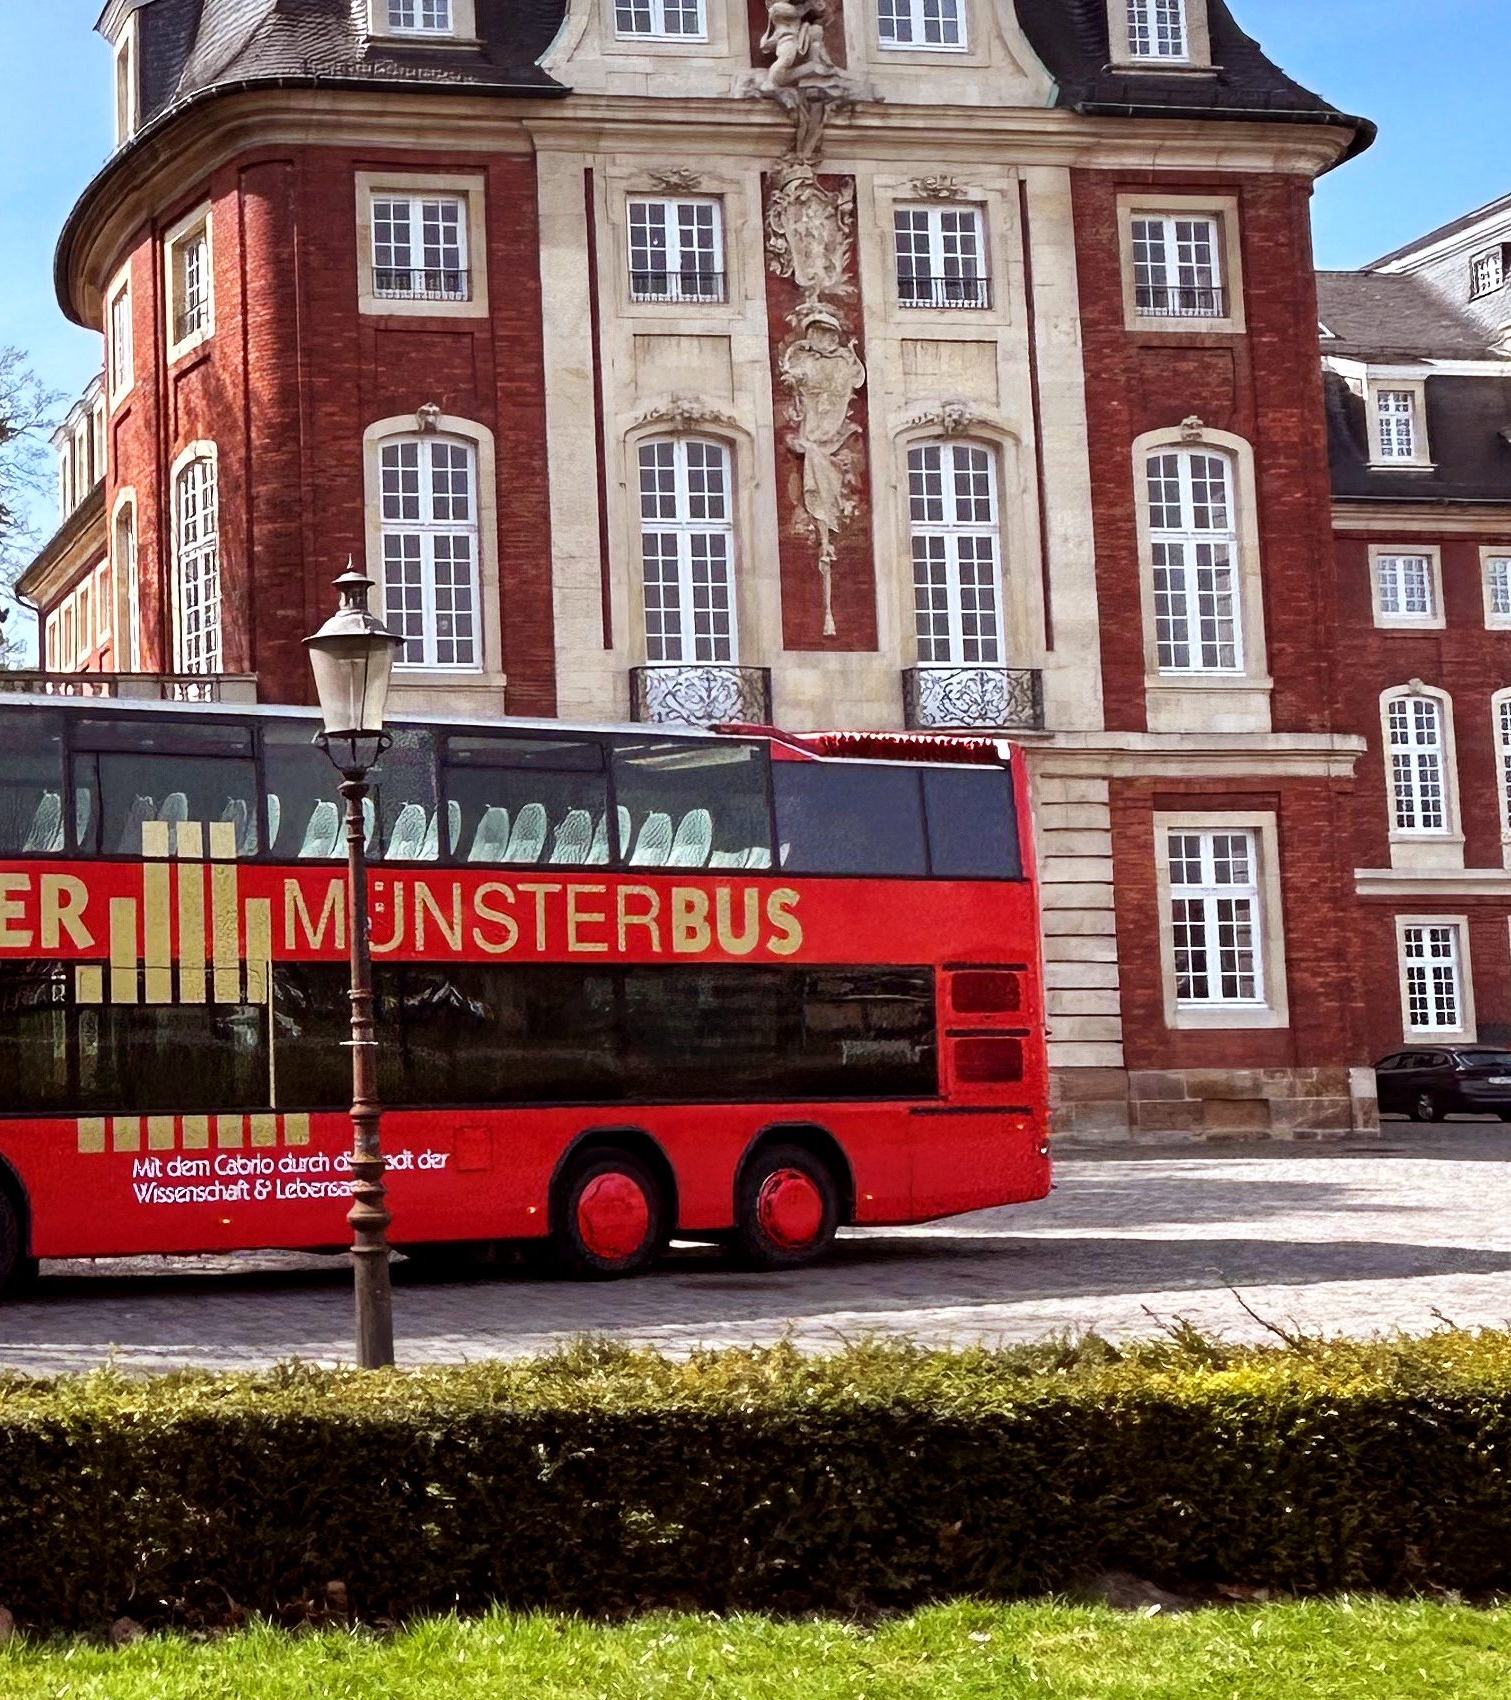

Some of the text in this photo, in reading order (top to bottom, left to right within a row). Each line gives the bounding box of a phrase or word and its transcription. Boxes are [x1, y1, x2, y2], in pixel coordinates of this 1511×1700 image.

[283, 878, 803, 956] MÜNSTERBUS
[133, 1156, 163, 1178] Mit
[167, 1155, 210, 1176] dem
[214, 1152, 275, 1176] Cabrio
[278, 1151, 330, 1173] durch
[417, 1148, 450, 1170] der
[133, 1179, 251, 1204] Wissenschaft
[253, 1178, 273, 1200] &
